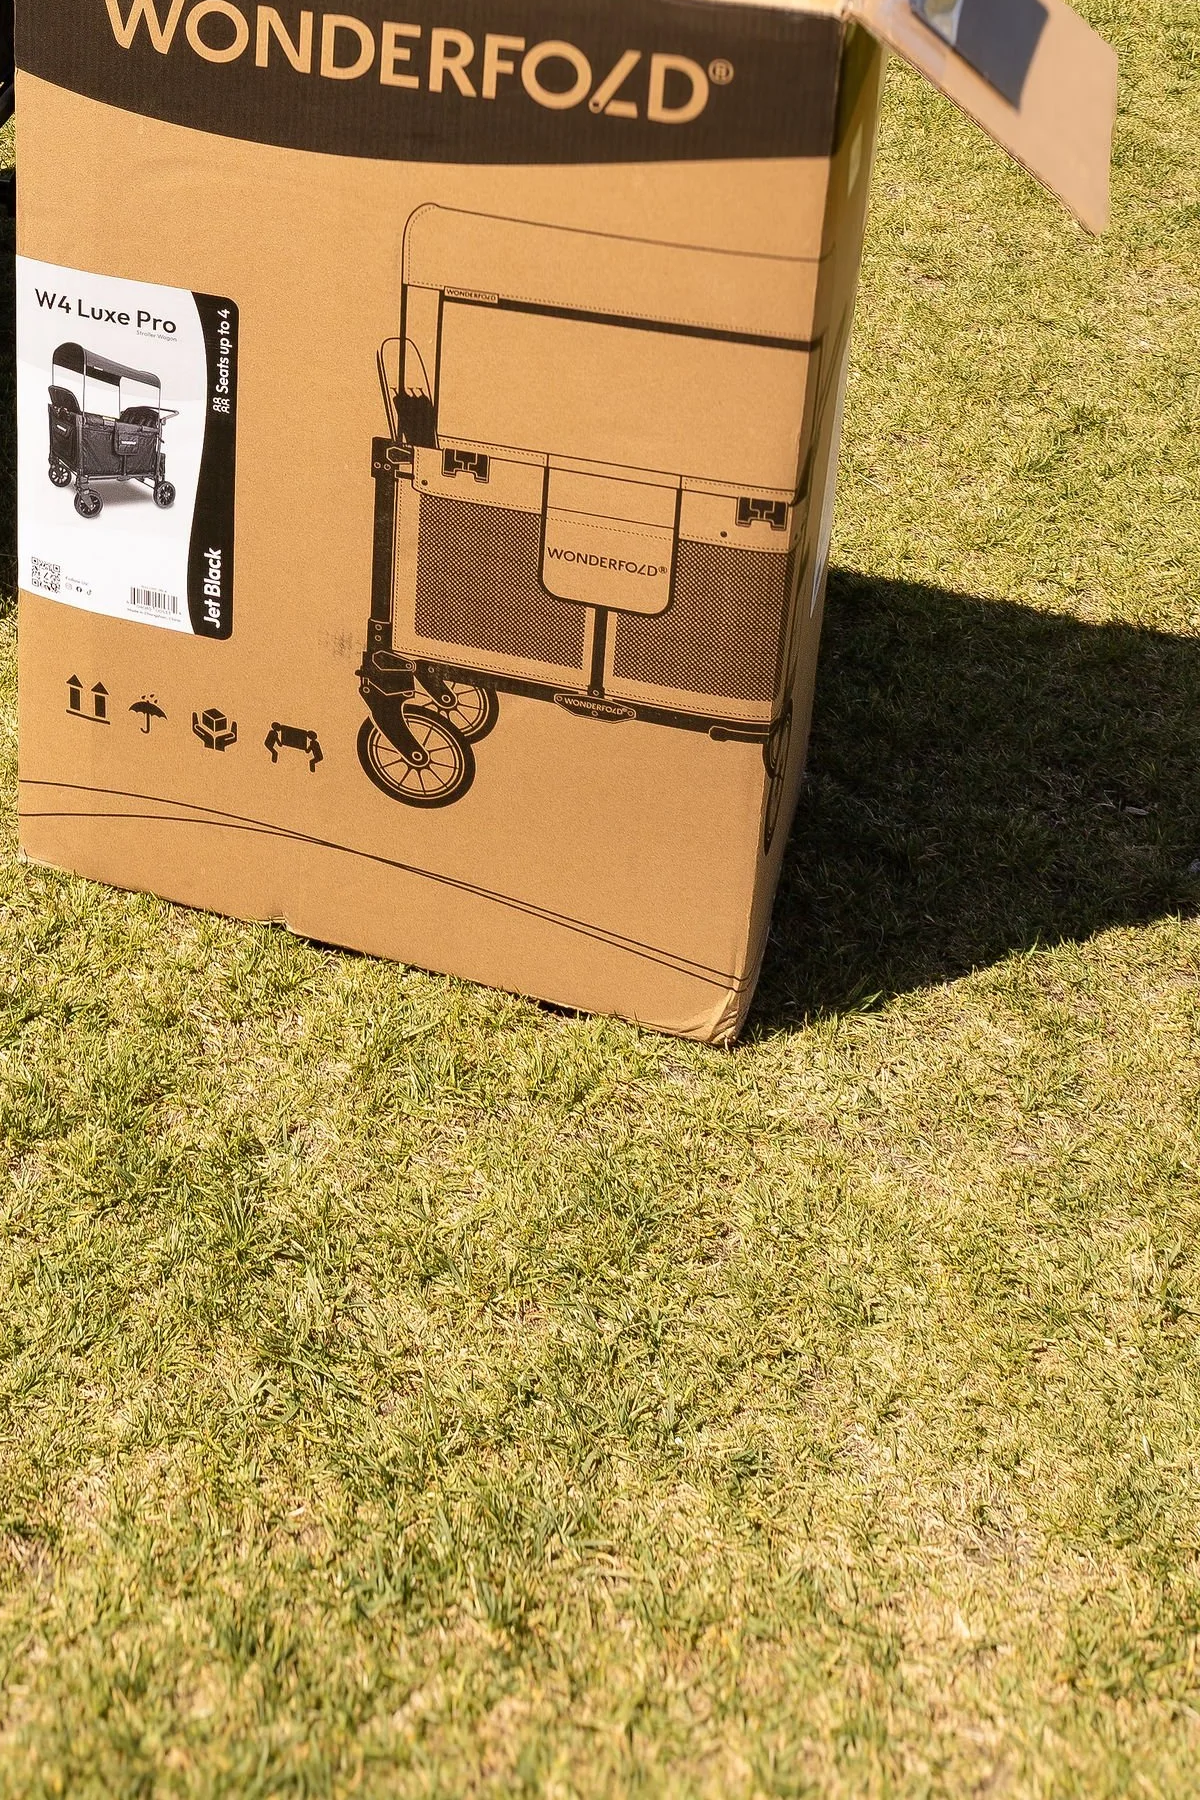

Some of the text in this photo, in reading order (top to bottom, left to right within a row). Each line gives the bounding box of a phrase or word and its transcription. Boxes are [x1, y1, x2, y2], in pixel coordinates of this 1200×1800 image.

[35, 288, 177, 333] W4 Luxe Pro
[215, 308, 233, 394] Seats up to 4
[203, 547, 222, 629] Jet Black
